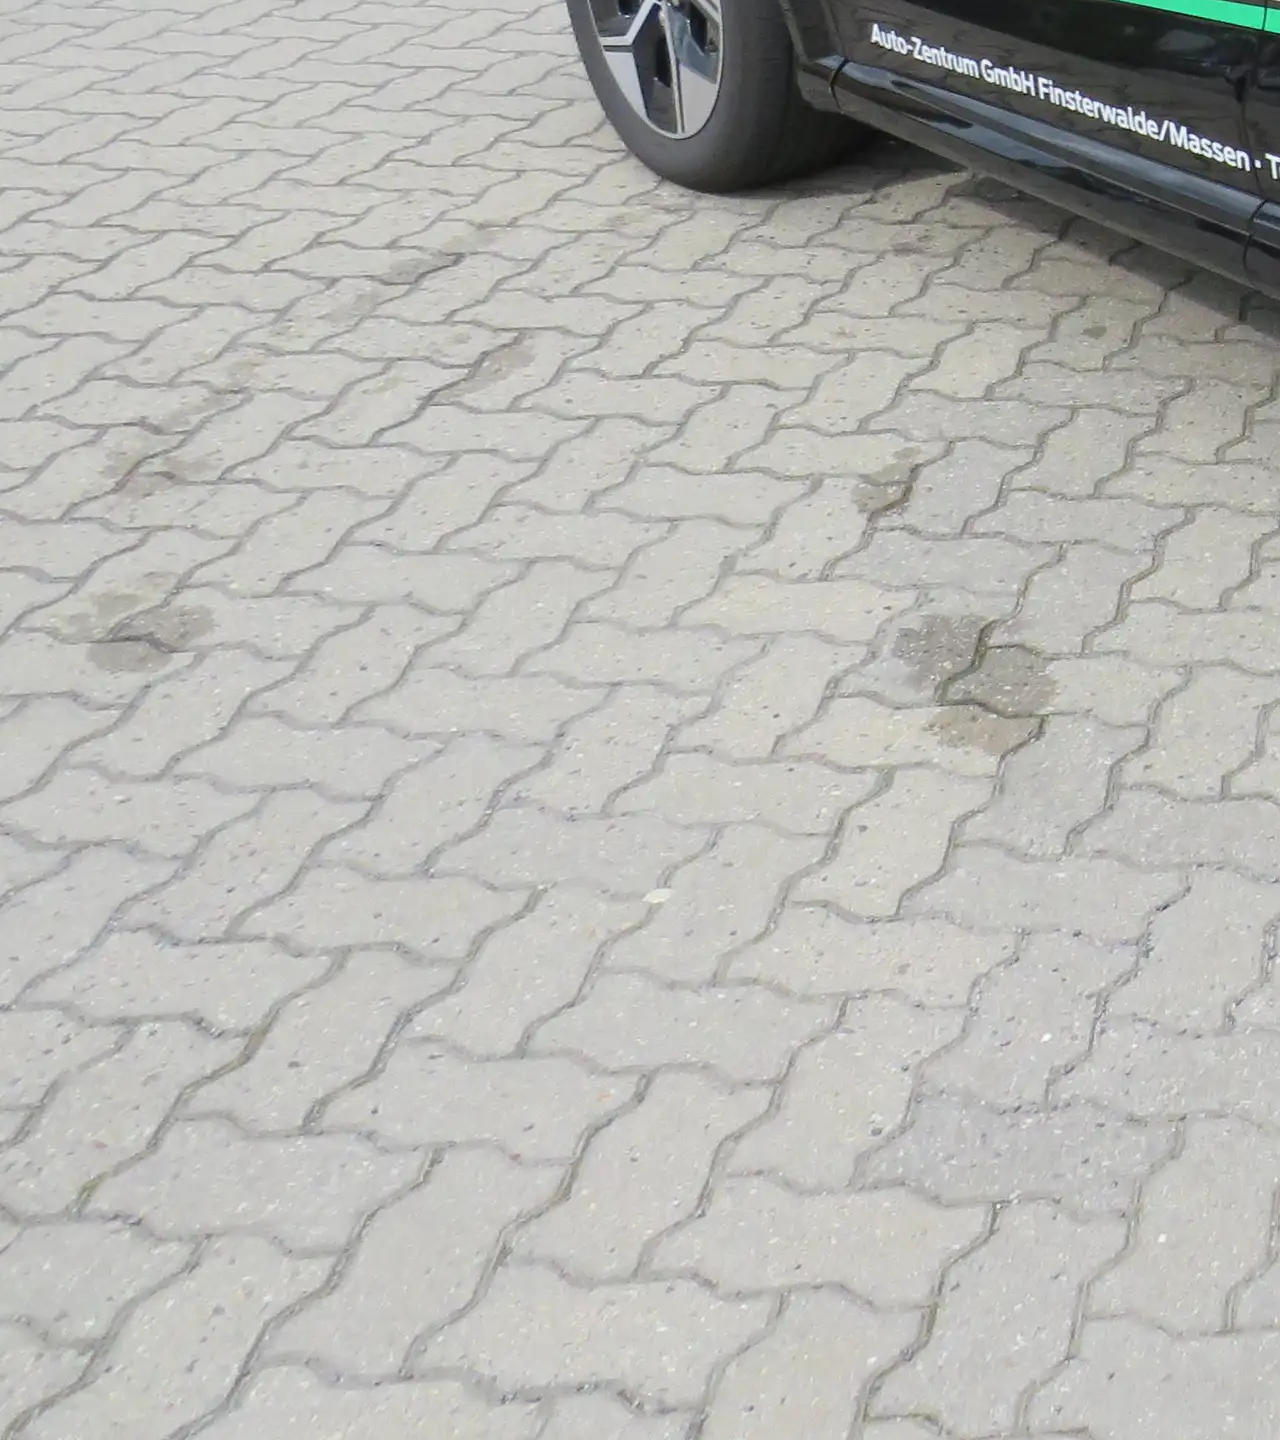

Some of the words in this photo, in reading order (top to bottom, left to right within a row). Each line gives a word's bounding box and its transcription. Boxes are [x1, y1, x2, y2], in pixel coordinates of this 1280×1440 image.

[870, 23, 980, 79] Auto-Zentrum
[980, 59, 1036, 98] GmbH
[1037, 76, 1251, 172] Finsterwalde/Massen
